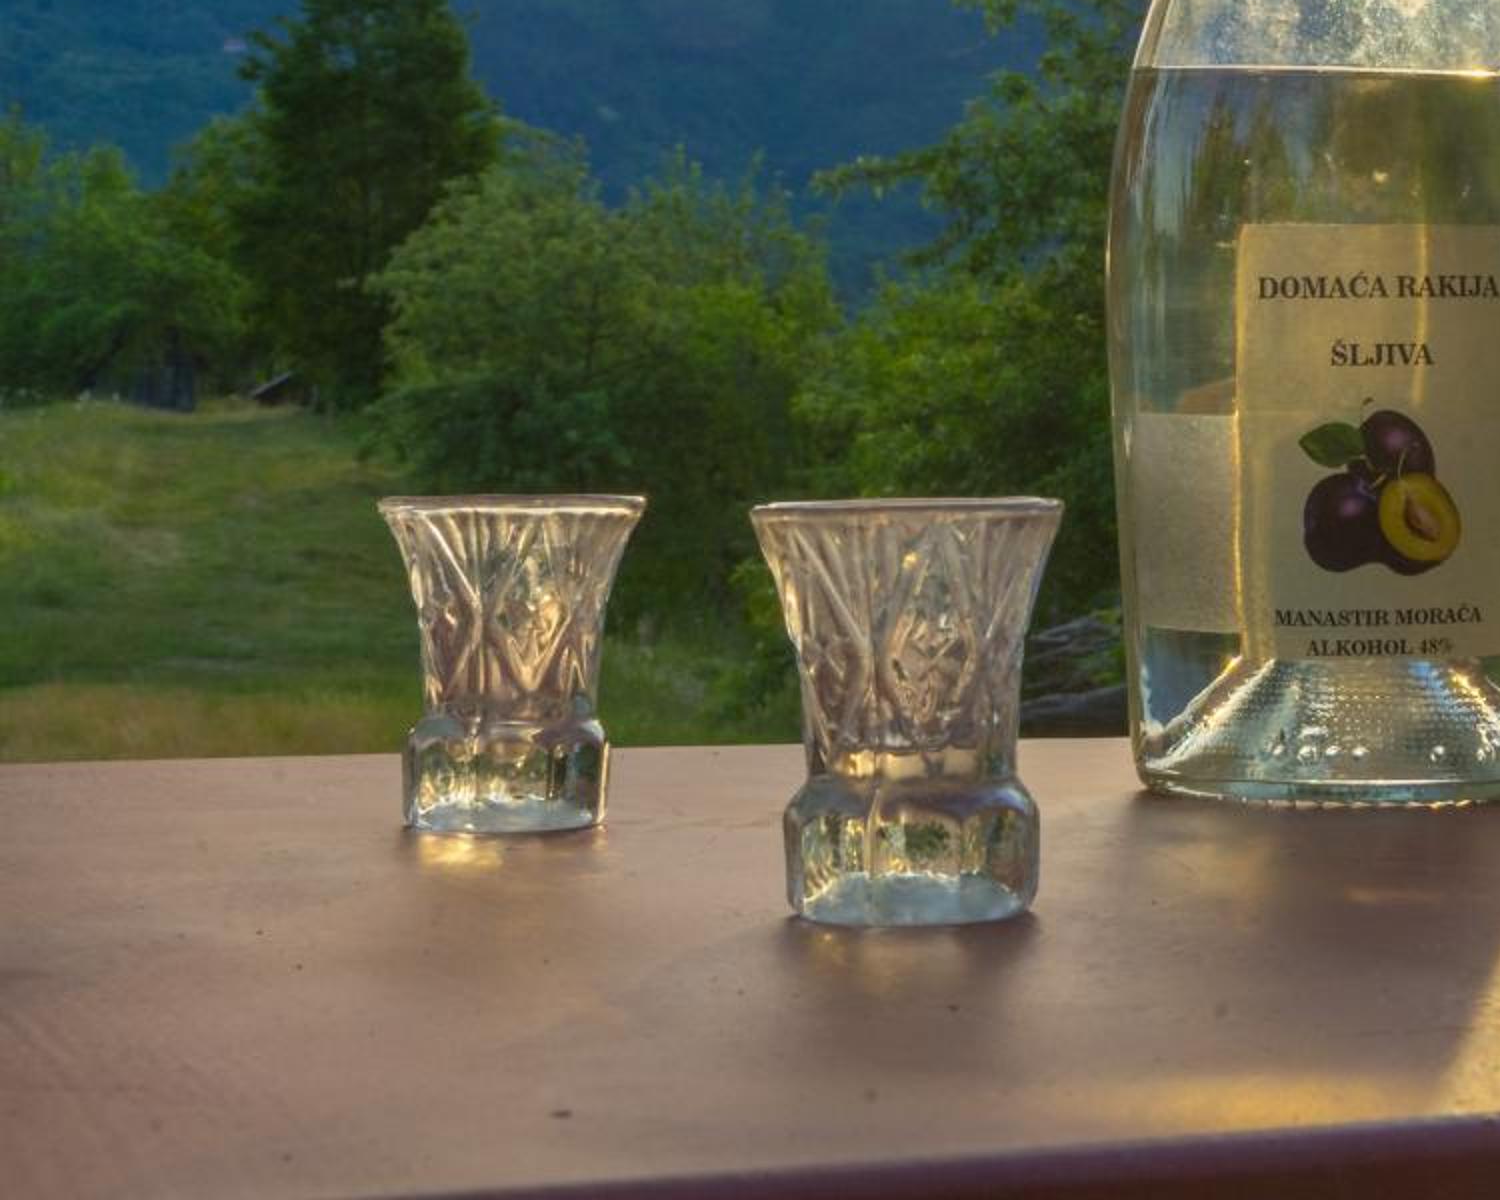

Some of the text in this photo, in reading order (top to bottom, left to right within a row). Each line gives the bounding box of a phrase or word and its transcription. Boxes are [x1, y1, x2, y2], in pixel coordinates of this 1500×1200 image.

[1258, 271, 1499, 299] DOMAĆA RAKIJA
[1275, 608, 1389, 626] MANASTIR
[1306, 638, 1413, 657] ALKOHOL
